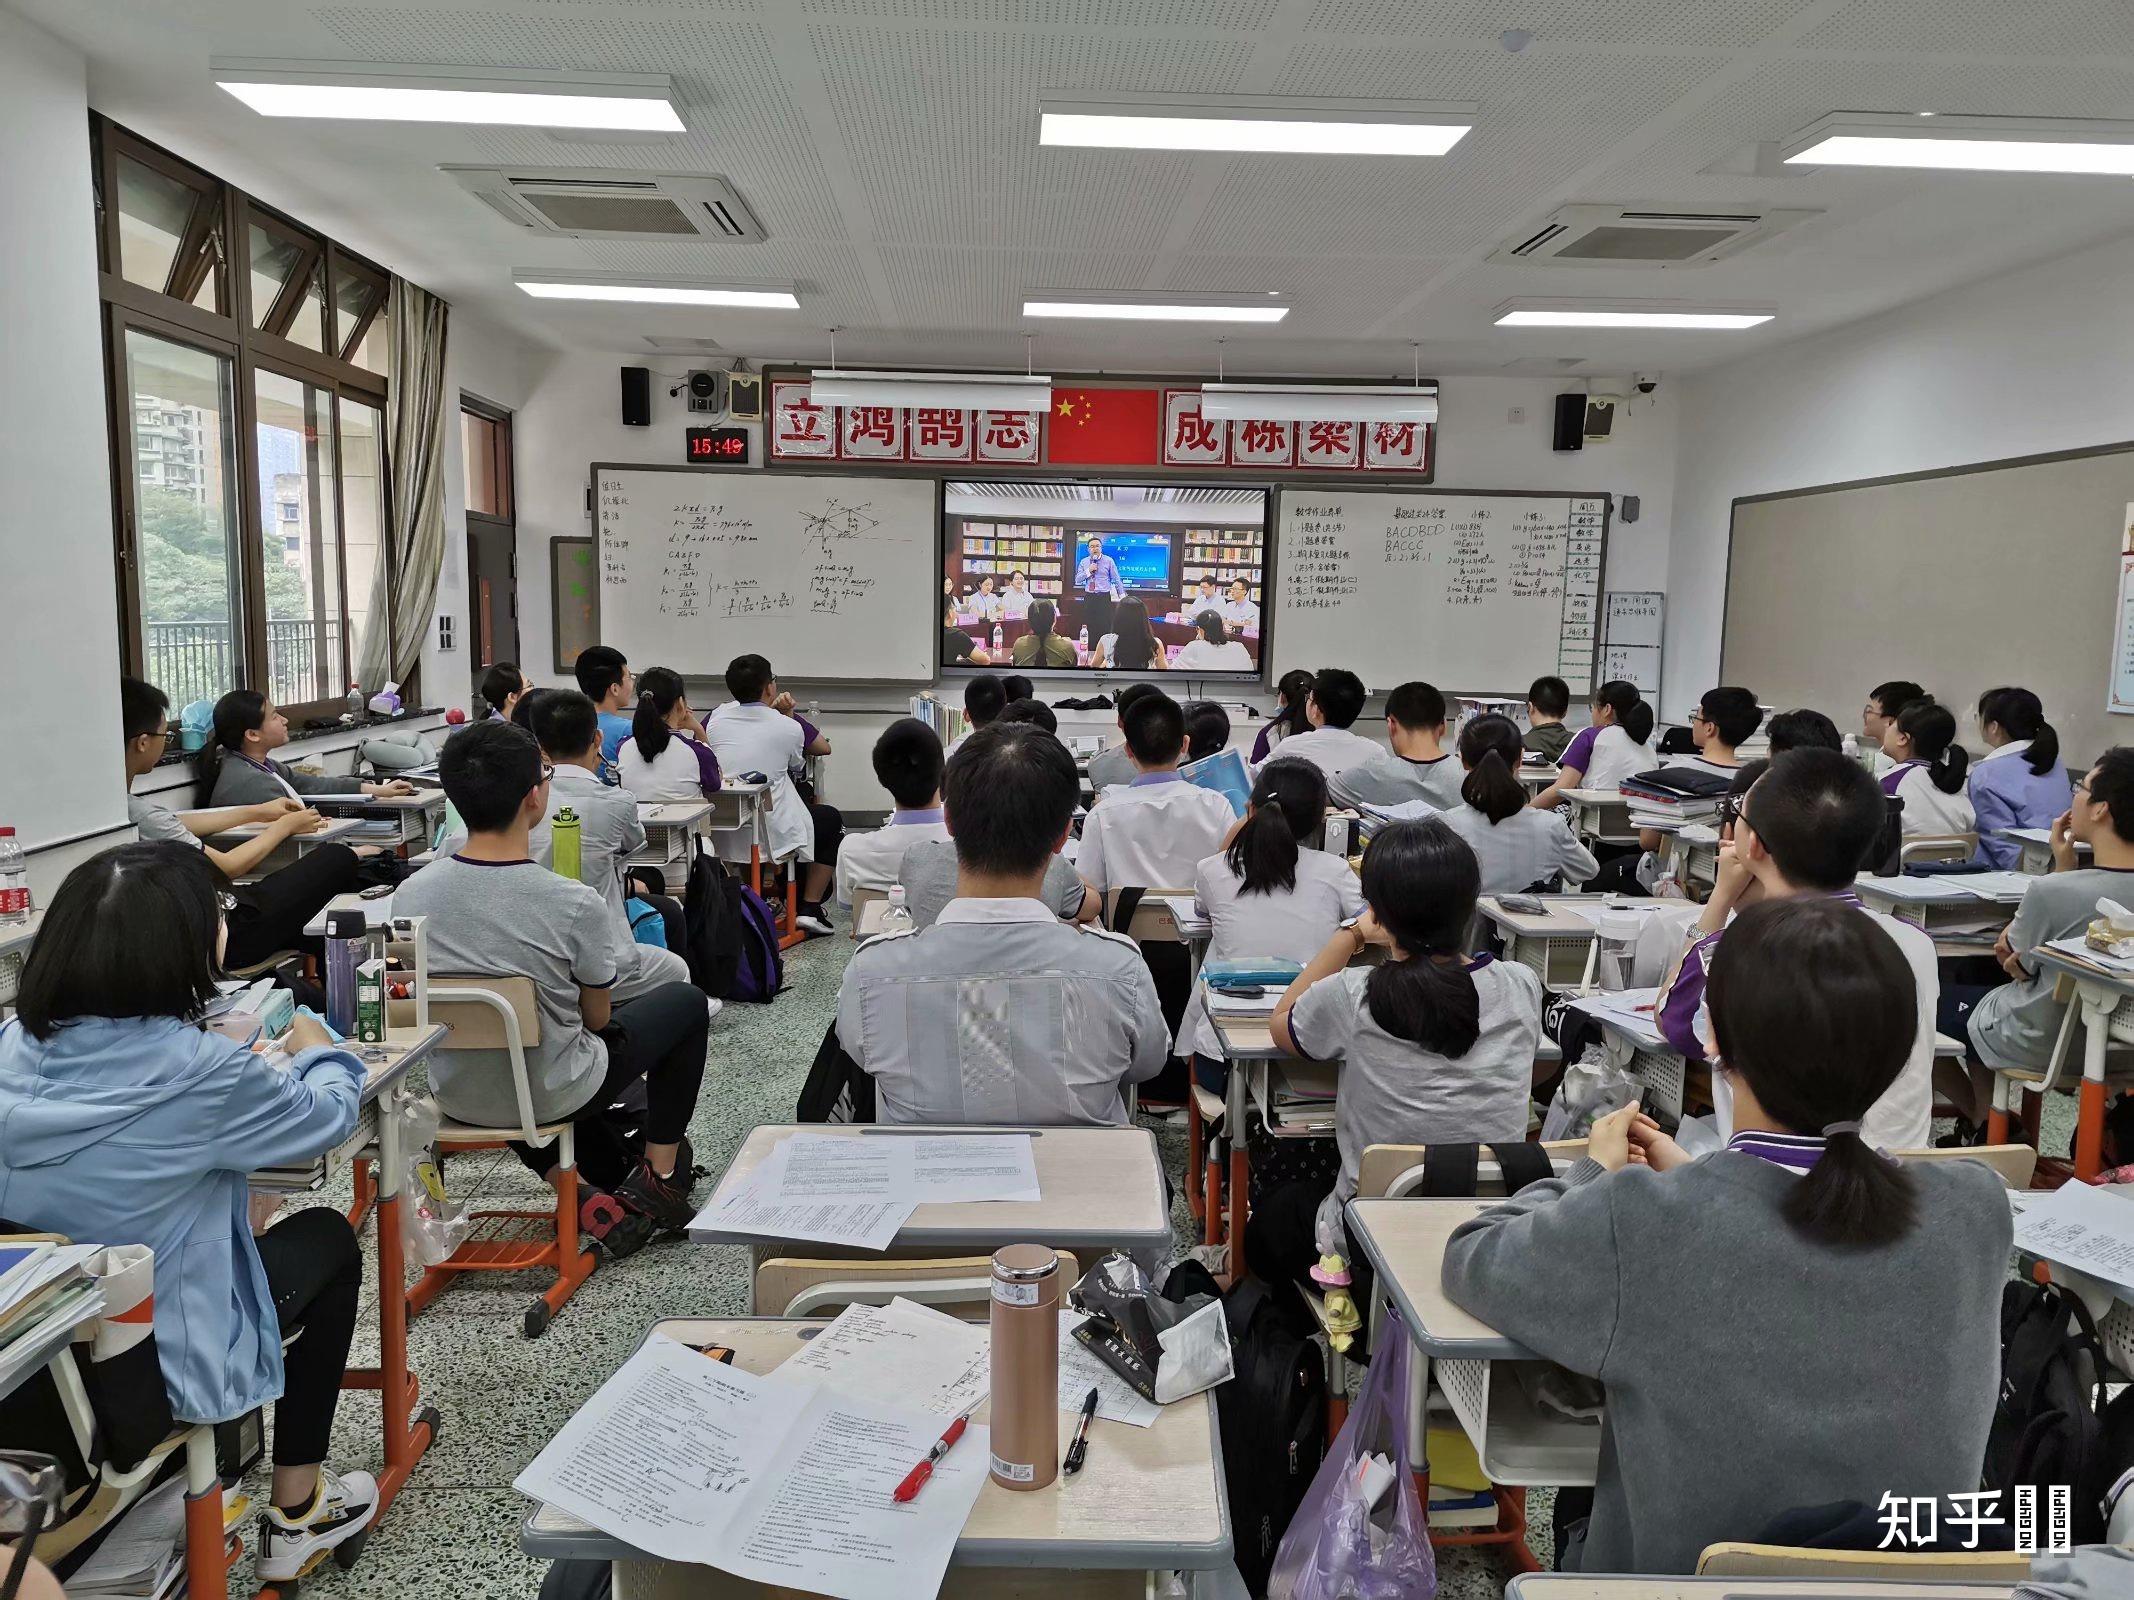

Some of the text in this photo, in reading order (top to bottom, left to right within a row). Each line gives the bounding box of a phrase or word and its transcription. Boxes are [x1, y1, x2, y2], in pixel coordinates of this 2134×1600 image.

[692, 438, 744, 454] 15:49
[781, 398, 1031, 449] 立鸿鹄志
[1174, 405, 1413, 455] 成栋梁材
